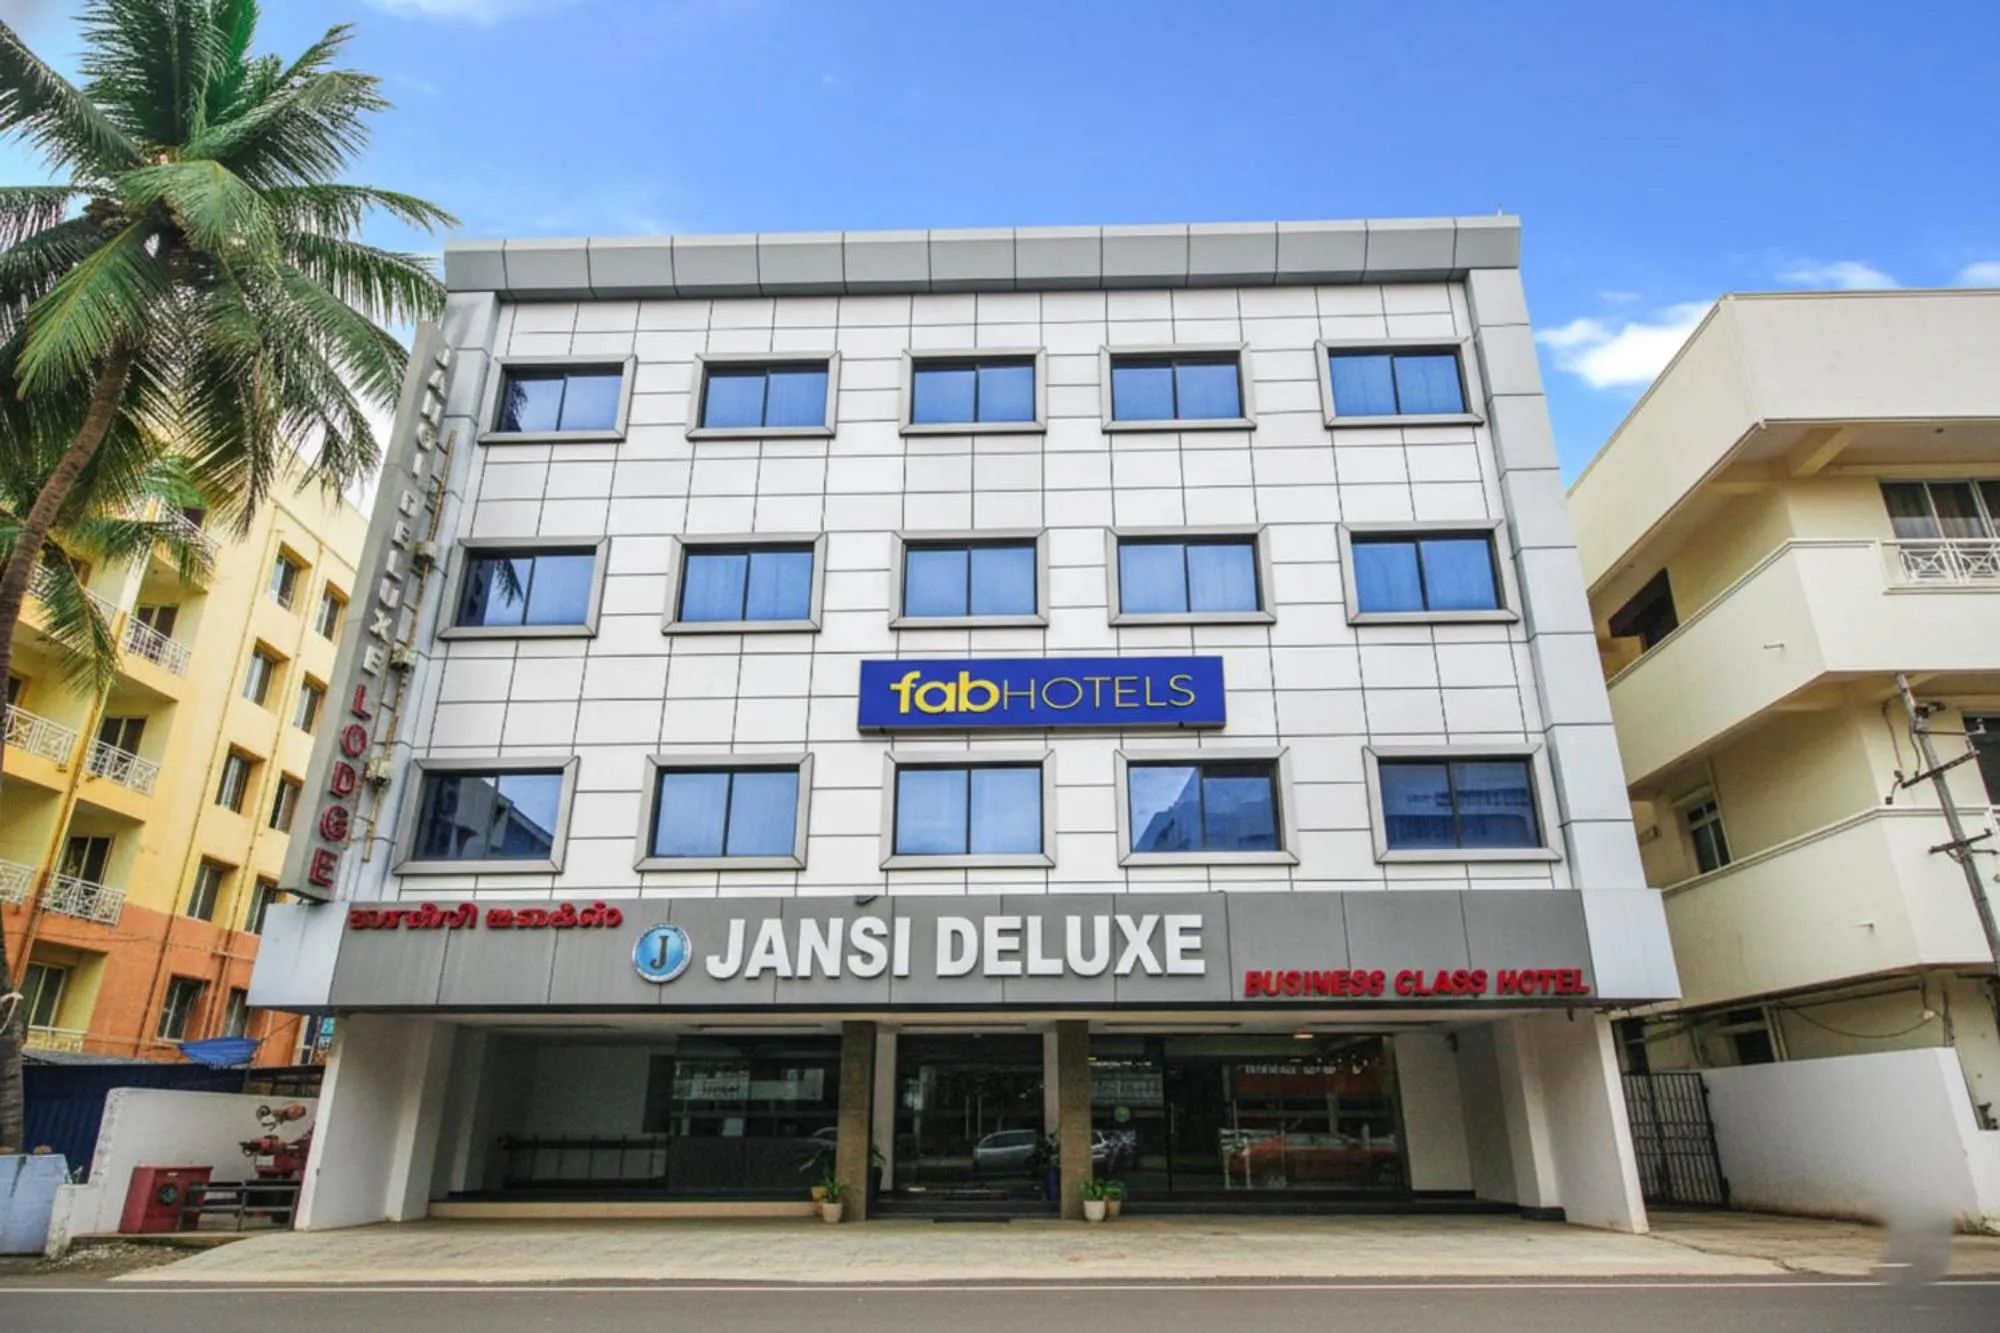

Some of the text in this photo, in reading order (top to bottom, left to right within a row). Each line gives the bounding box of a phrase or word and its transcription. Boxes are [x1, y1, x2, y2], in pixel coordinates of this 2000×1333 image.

[362, 489, 418, 677] DELUXE
[890, 670, 1196, 714] fabHOTELS
[308, 683, 373, 887] LODGE
[650, 935, 670, 969] J
[705, 914, 1206, 979] JANSI DELUXE
[1244, 968, 1591, 998] BUSINESS CLASS HOTEL
